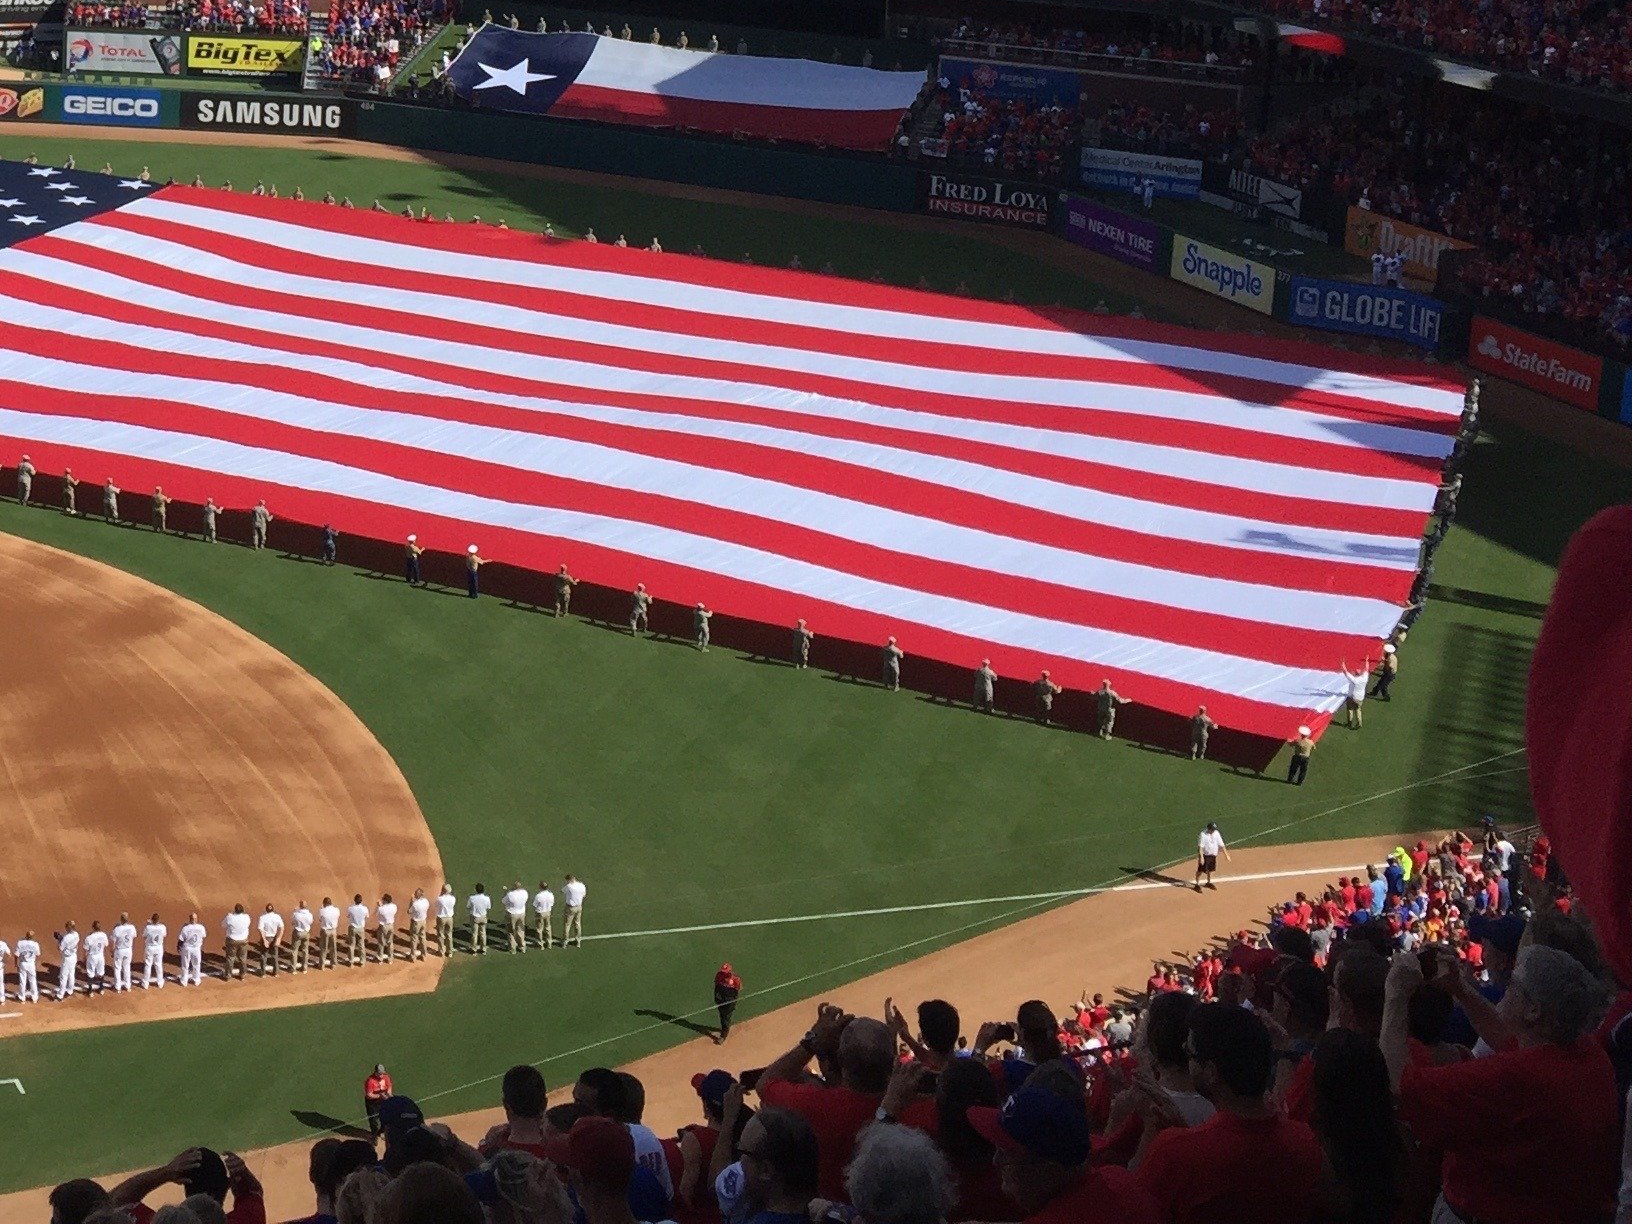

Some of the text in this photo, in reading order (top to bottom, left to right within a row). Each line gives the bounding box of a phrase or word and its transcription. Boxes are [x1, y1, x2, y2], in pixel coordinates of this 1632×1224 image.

[99, 44, 147, 58] TOTAL
[63, 94, 159, 118] GEICO
[196, 98, 342, 129] SAMSUNG
[929, 175, 988, 202] FRED
[994, 182, 1049, 212] LOYA
[928, 198, 1048, 226] INSURANCE
[1088, 217, 1125, 244] NEXEN
[1128, 232, 1154, 254] TIRE
[1182, 242, 1262, 297] Snapple
[1324, 289, 1406, 330] GLOBE
